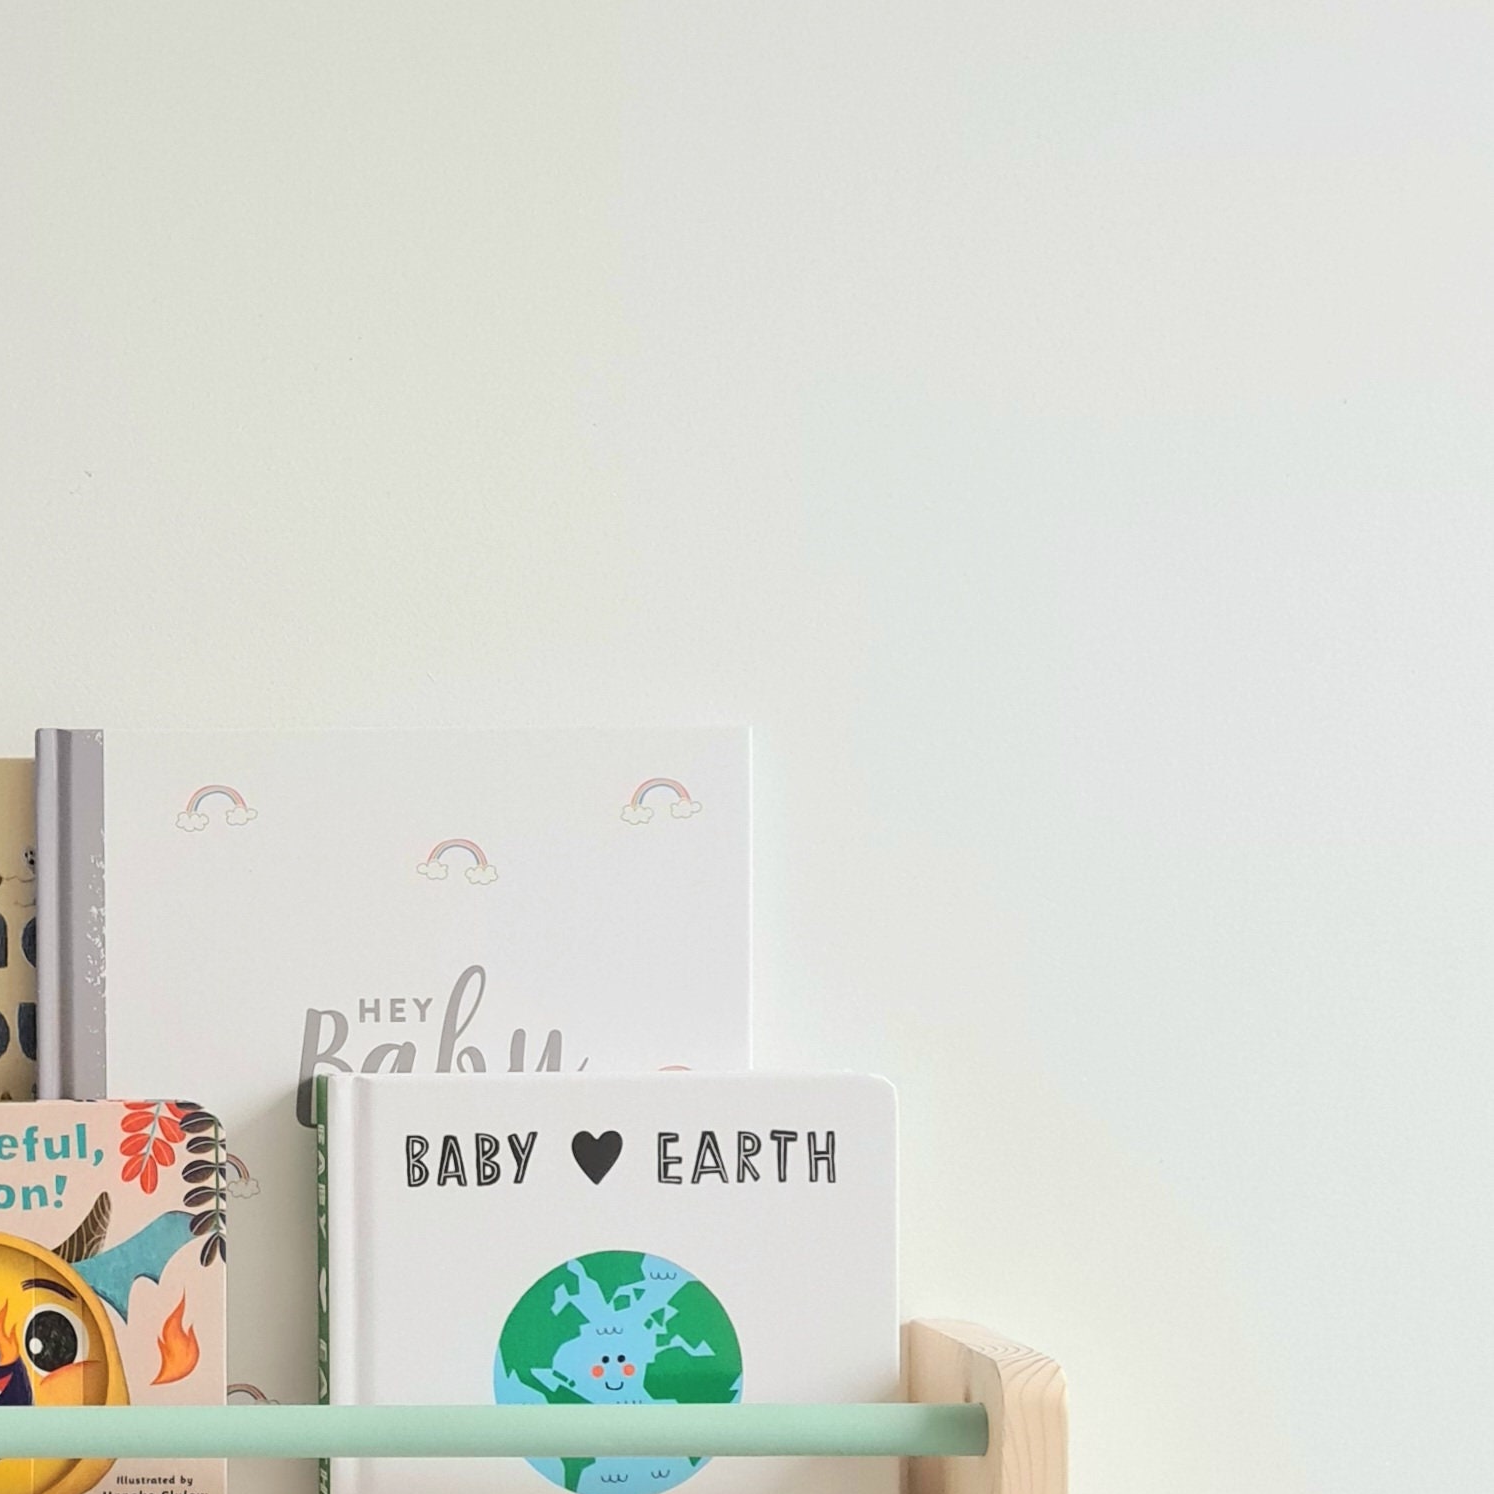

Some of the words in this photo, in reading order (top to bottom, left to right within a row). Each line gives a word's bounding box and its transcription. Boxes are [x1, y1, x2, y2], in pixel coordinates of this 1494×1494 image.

[358, 998, 434, 1023] HEY
[405, 1132, 538, 1187] BABY
[656, 1129, 837, 1185] EARTH
[116, 1475, 176, 1485] Illustrated
[180, 1475, 194, 1487] by
